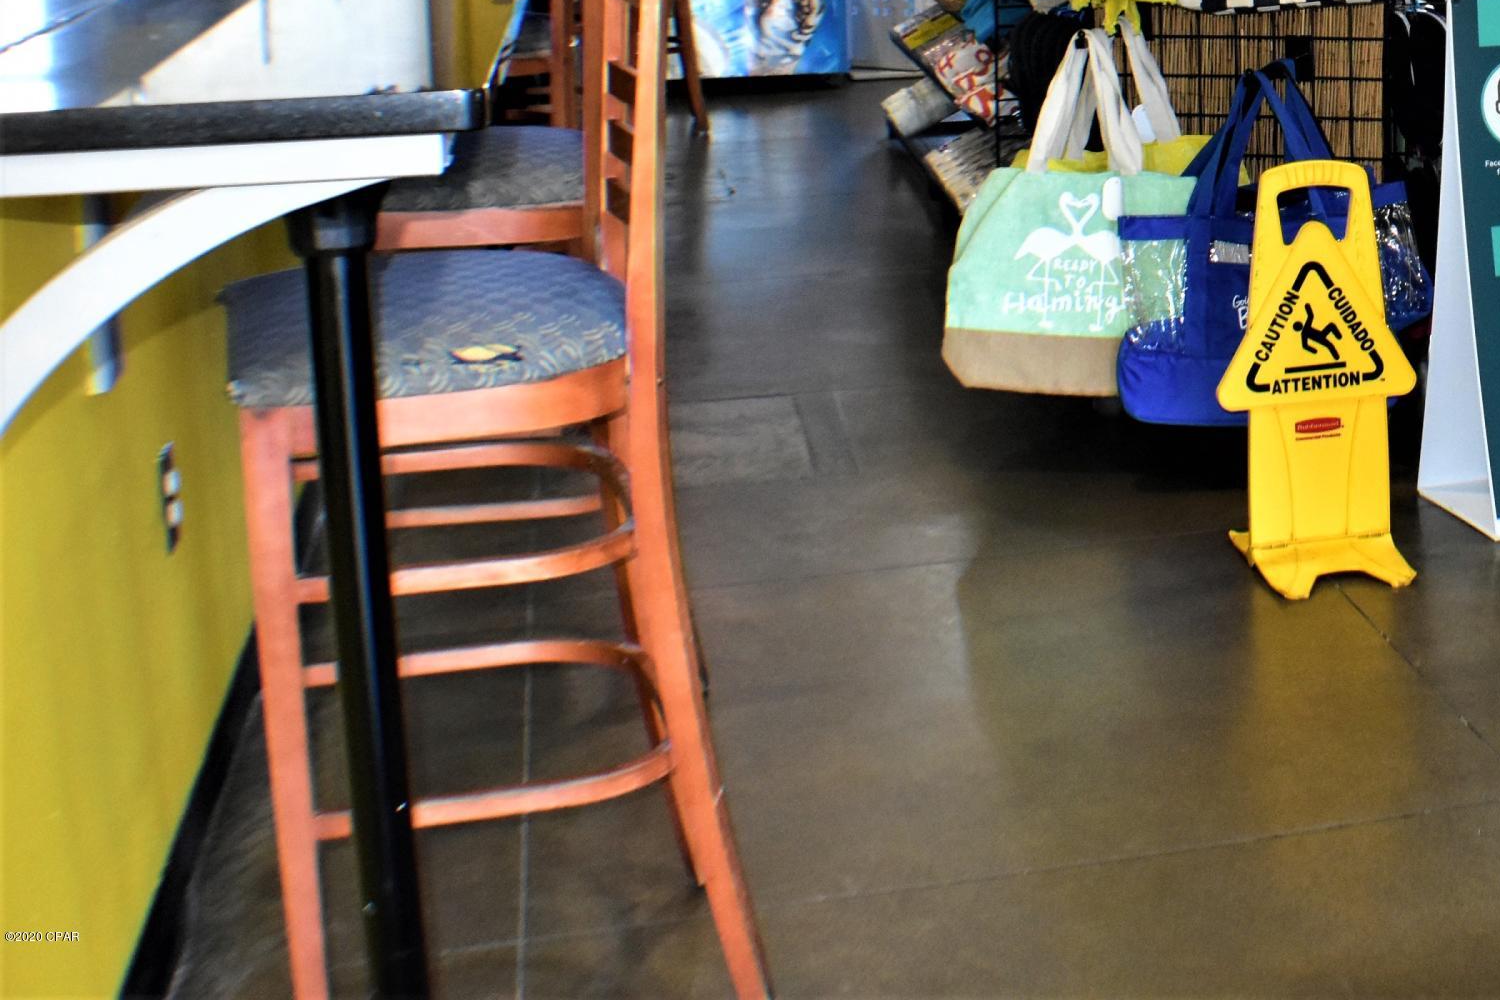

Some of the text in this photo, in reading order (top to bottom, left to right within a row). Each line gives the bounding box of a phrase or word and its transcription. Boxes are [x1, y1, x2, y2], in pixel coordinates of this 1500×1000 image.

[1054, 257, 1097, 273] READY
[1064, 274, 1086, 289] TO
[1255, 290, 1300, 362] CAUTION
[1328, 287, 1375, 352] CUIDADO
[1272, 370, 1360, 395] ATTENTION
